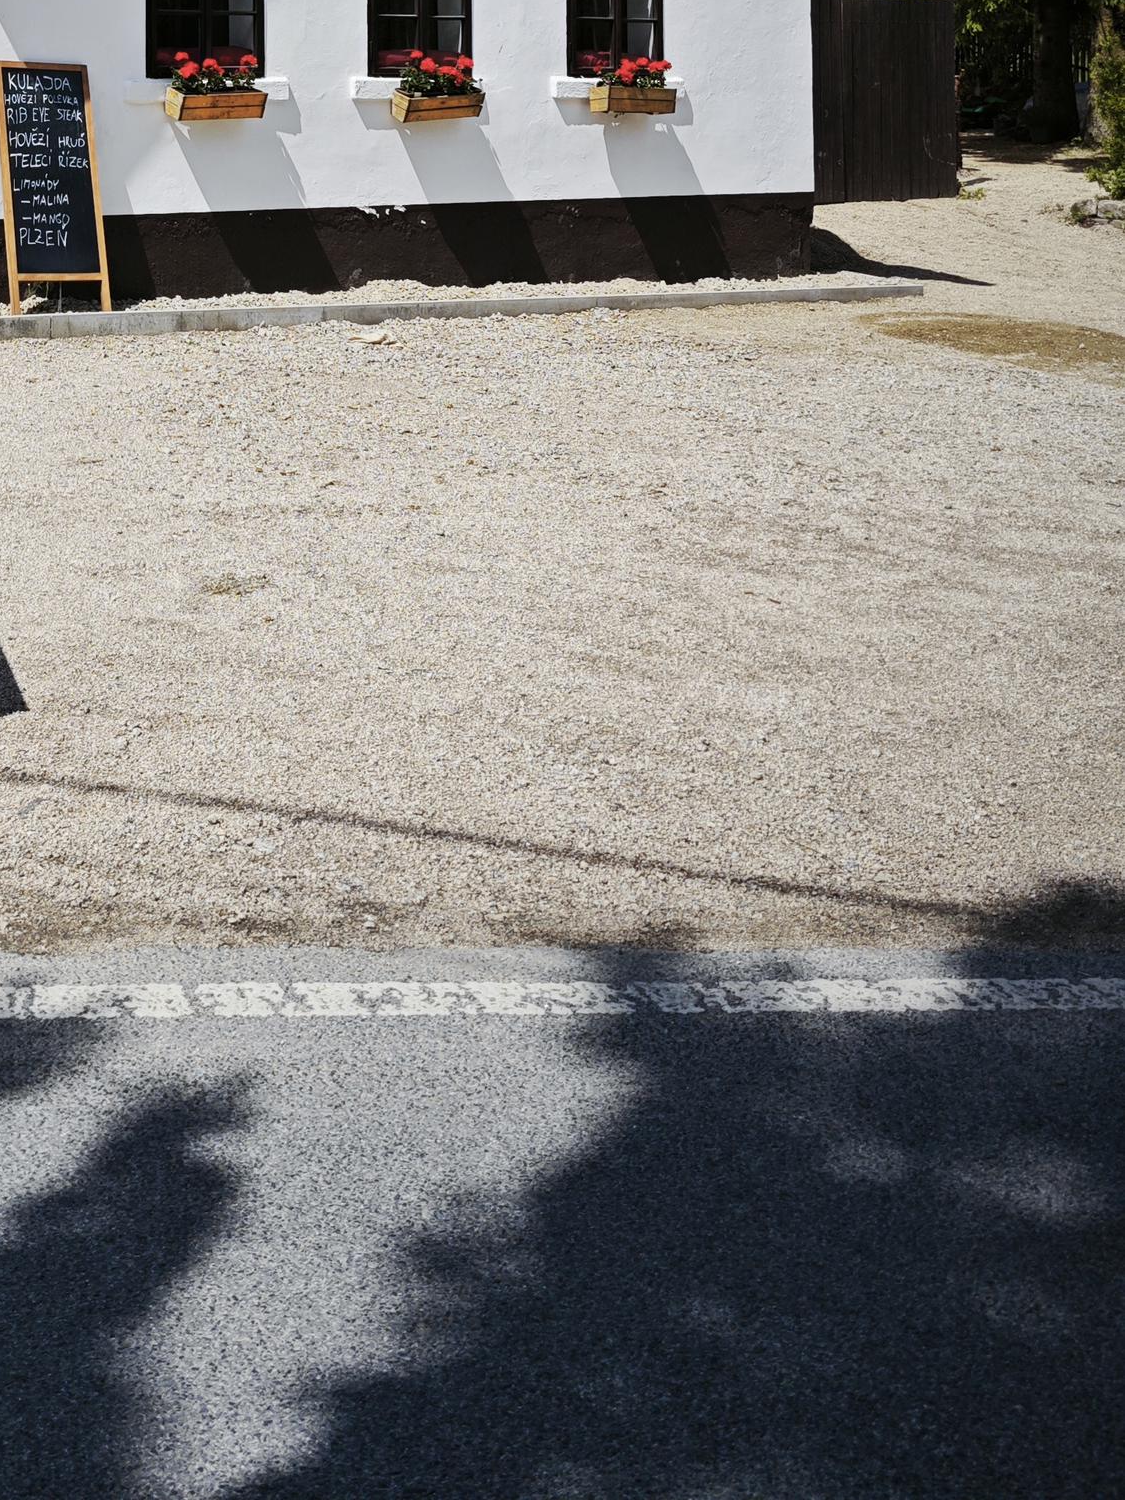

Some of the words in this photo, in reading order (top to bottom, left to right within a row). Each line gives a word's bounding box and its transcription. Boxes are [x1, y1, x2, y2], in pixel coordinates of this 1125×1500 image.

[7, 72, 72, 91] KULAJDA
[7, 107, 28, 124] RIB
[32, 107, 51, 123] EYE
[56, 108, 83, 122] STEAK
[9, 127, 50, 148] HOVĚZÍ
